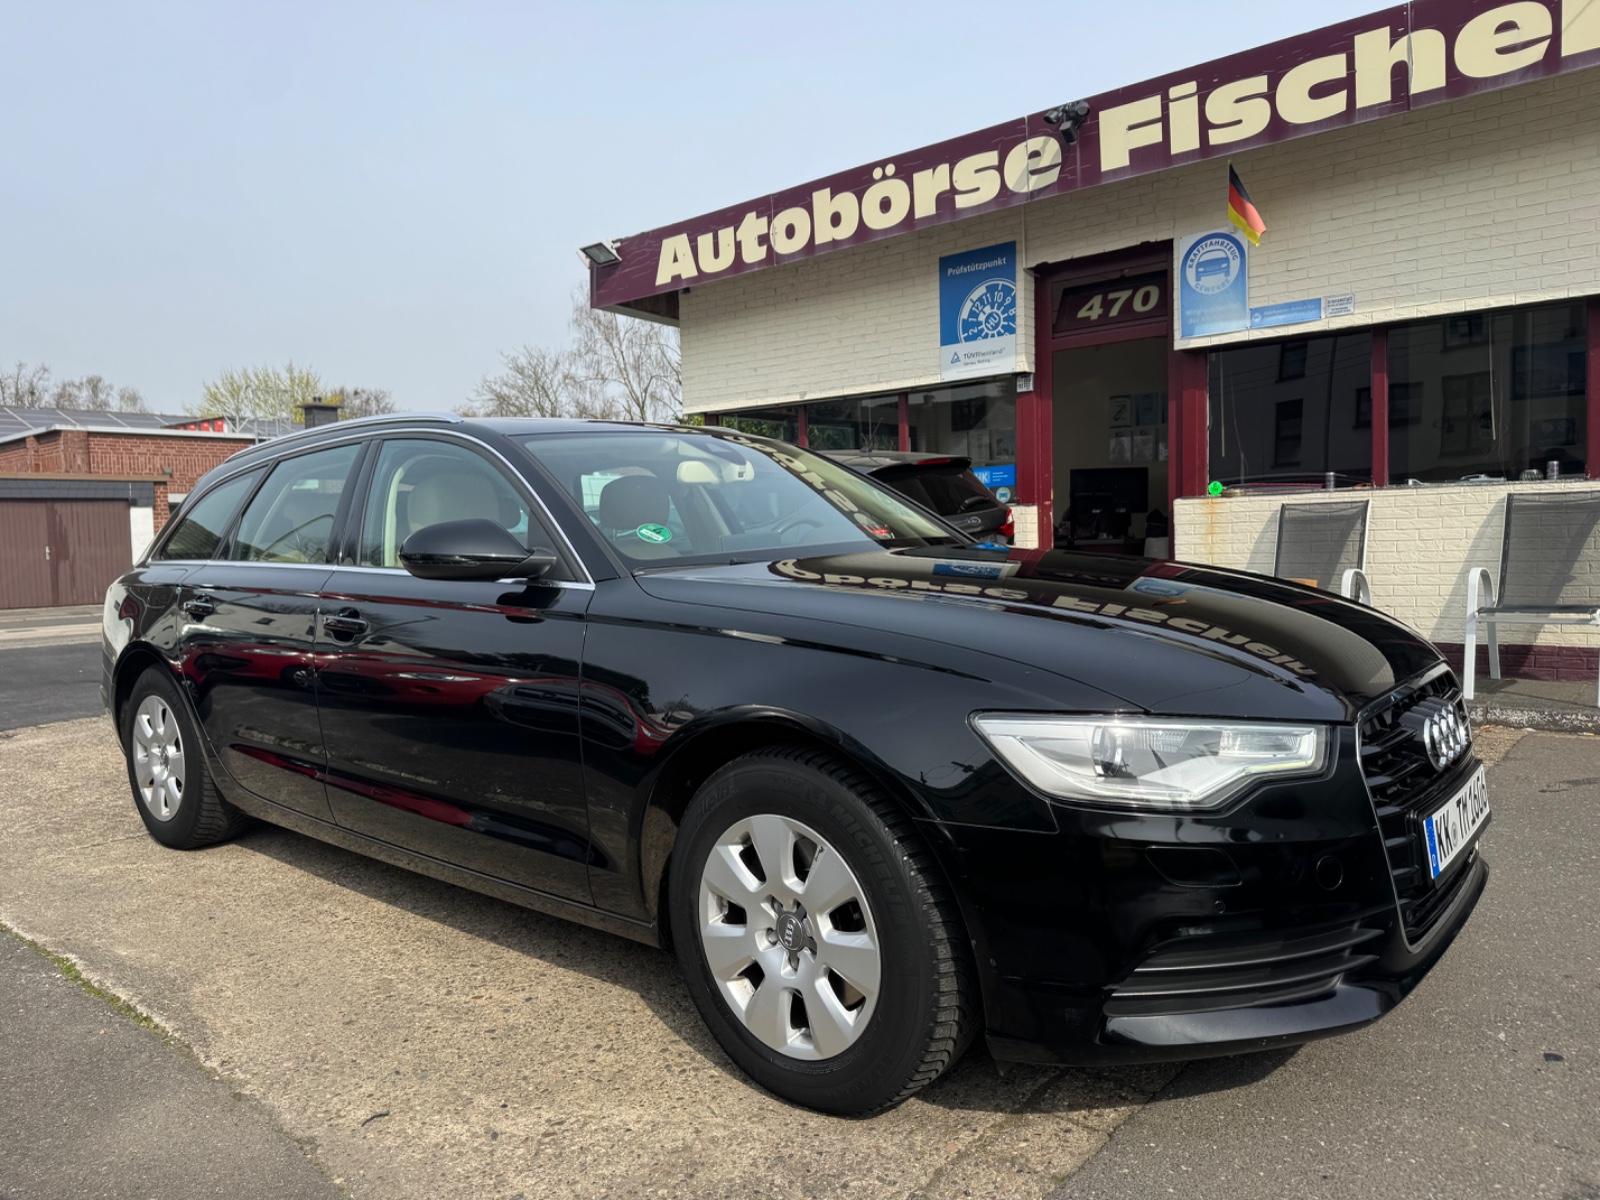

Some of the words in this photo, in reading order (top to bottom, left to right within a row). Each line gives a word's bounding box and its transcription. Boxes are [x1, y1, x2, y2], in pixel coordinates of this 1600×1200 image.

[655, 135, 1062, 287] Autobörse
[947, 257, 1007, 277] Prüfstützpunkt
[1188, 239, 1239, 269] KRAFTFAHRZEUG
[1076, 285, 1160, 321] 470
